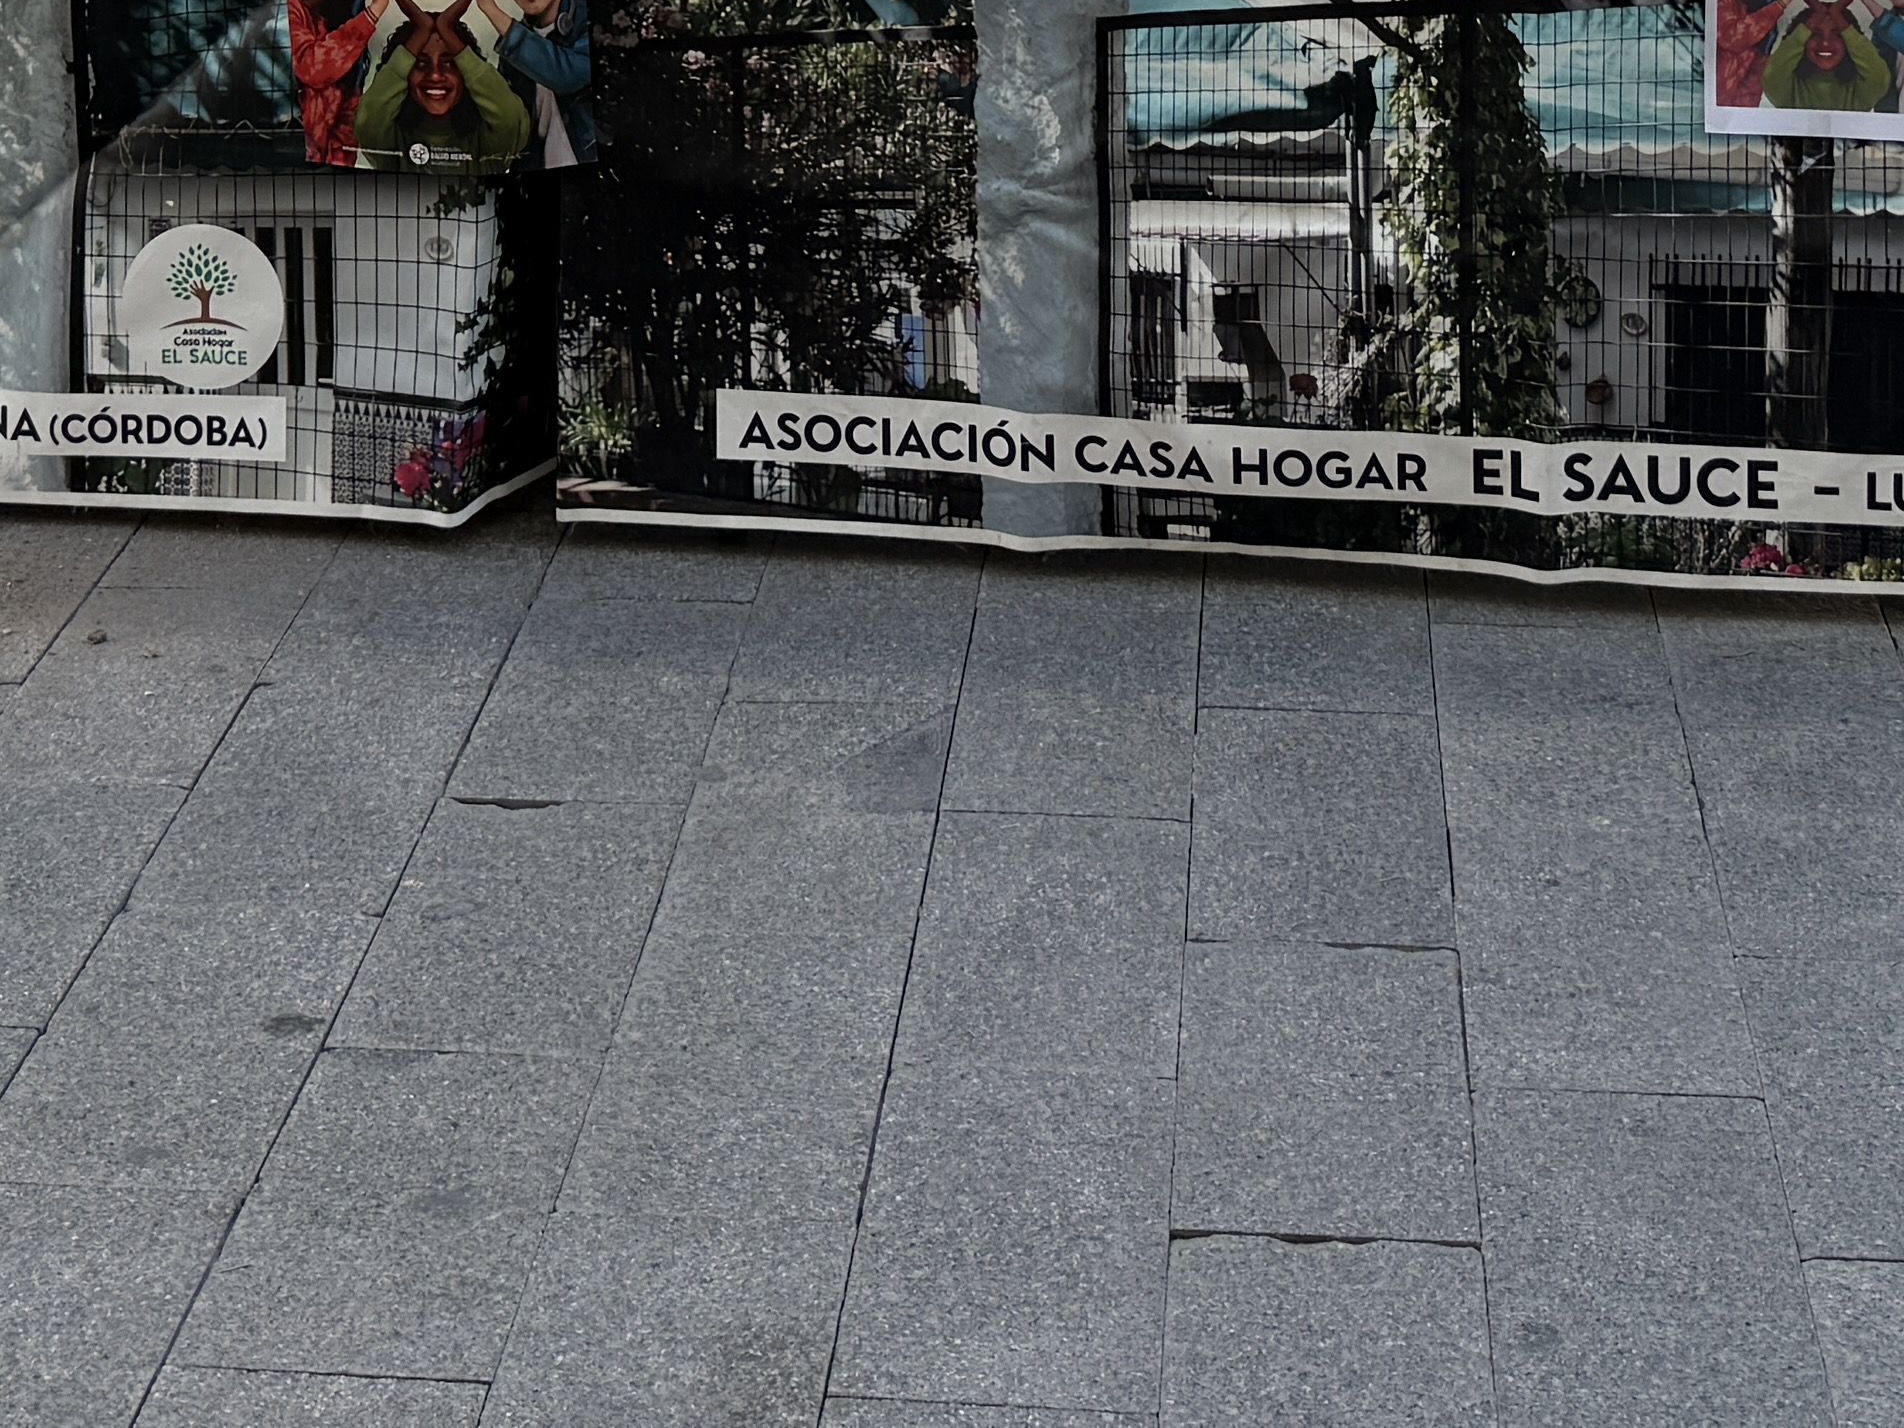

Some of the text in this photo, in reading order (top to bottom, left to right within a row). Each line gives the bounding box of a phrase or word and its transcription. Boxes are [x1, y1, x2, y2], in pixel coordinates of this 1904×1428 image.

[161, 349, 248, 366] EL SAUCE
[174, 337, 234, 350] Casa Hogar
[49, 406, 268, 451] (CÓRDOBA)
[738, 410, 1056, 472] ASOCIACIÓN
[1074, 435, 1214, 484] CASA
[1232, 446, 1428, 492] HOGAR
[1472, 448, 1541, 504] EL
[1563, 450, 1780, 511] SAUCE
